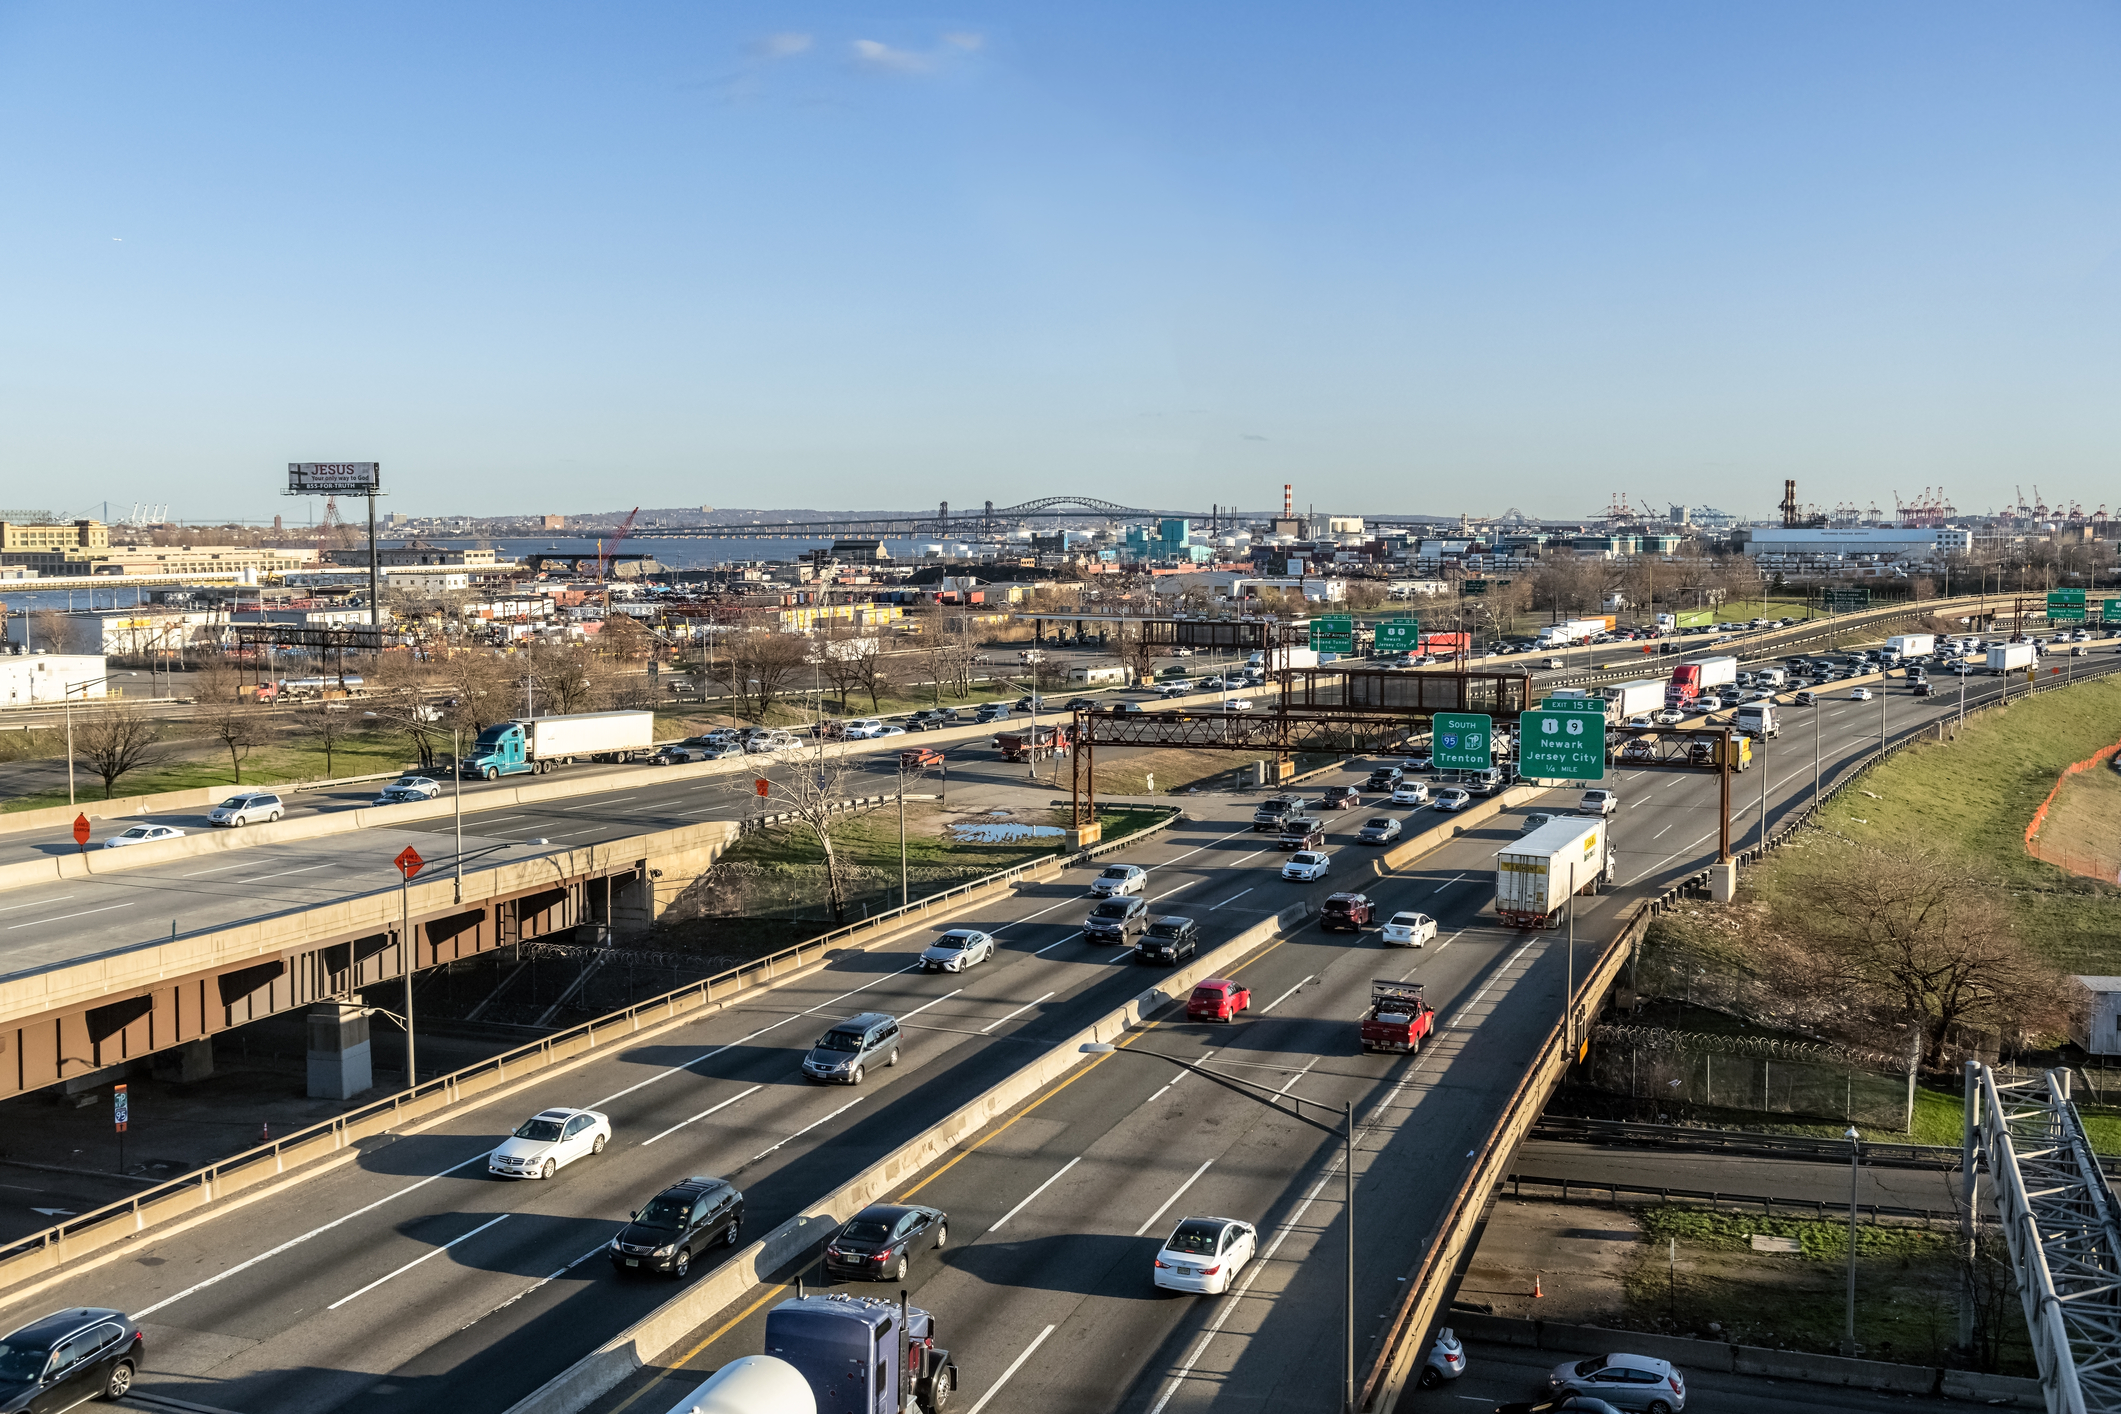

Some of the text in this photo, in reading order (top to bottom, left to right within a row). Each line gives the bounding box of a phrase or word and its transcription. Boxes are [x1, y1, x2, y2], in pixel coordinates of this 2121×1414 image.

[311, 464, 354, 475] JESUS
[1573, 702, 1584, 710] 15
[1448, 720, 1476, 729] SOUTH
[1572, 723, 1577, 732] 9
[1444, 737, 1456, 745] 95
[1541, 739, 1583, 749] Newark
[1440, 753, 1484, 763] Trenton
[1526, 751, 1597, 764] Jersey City
[116, 1111, 126, 1120] 95
